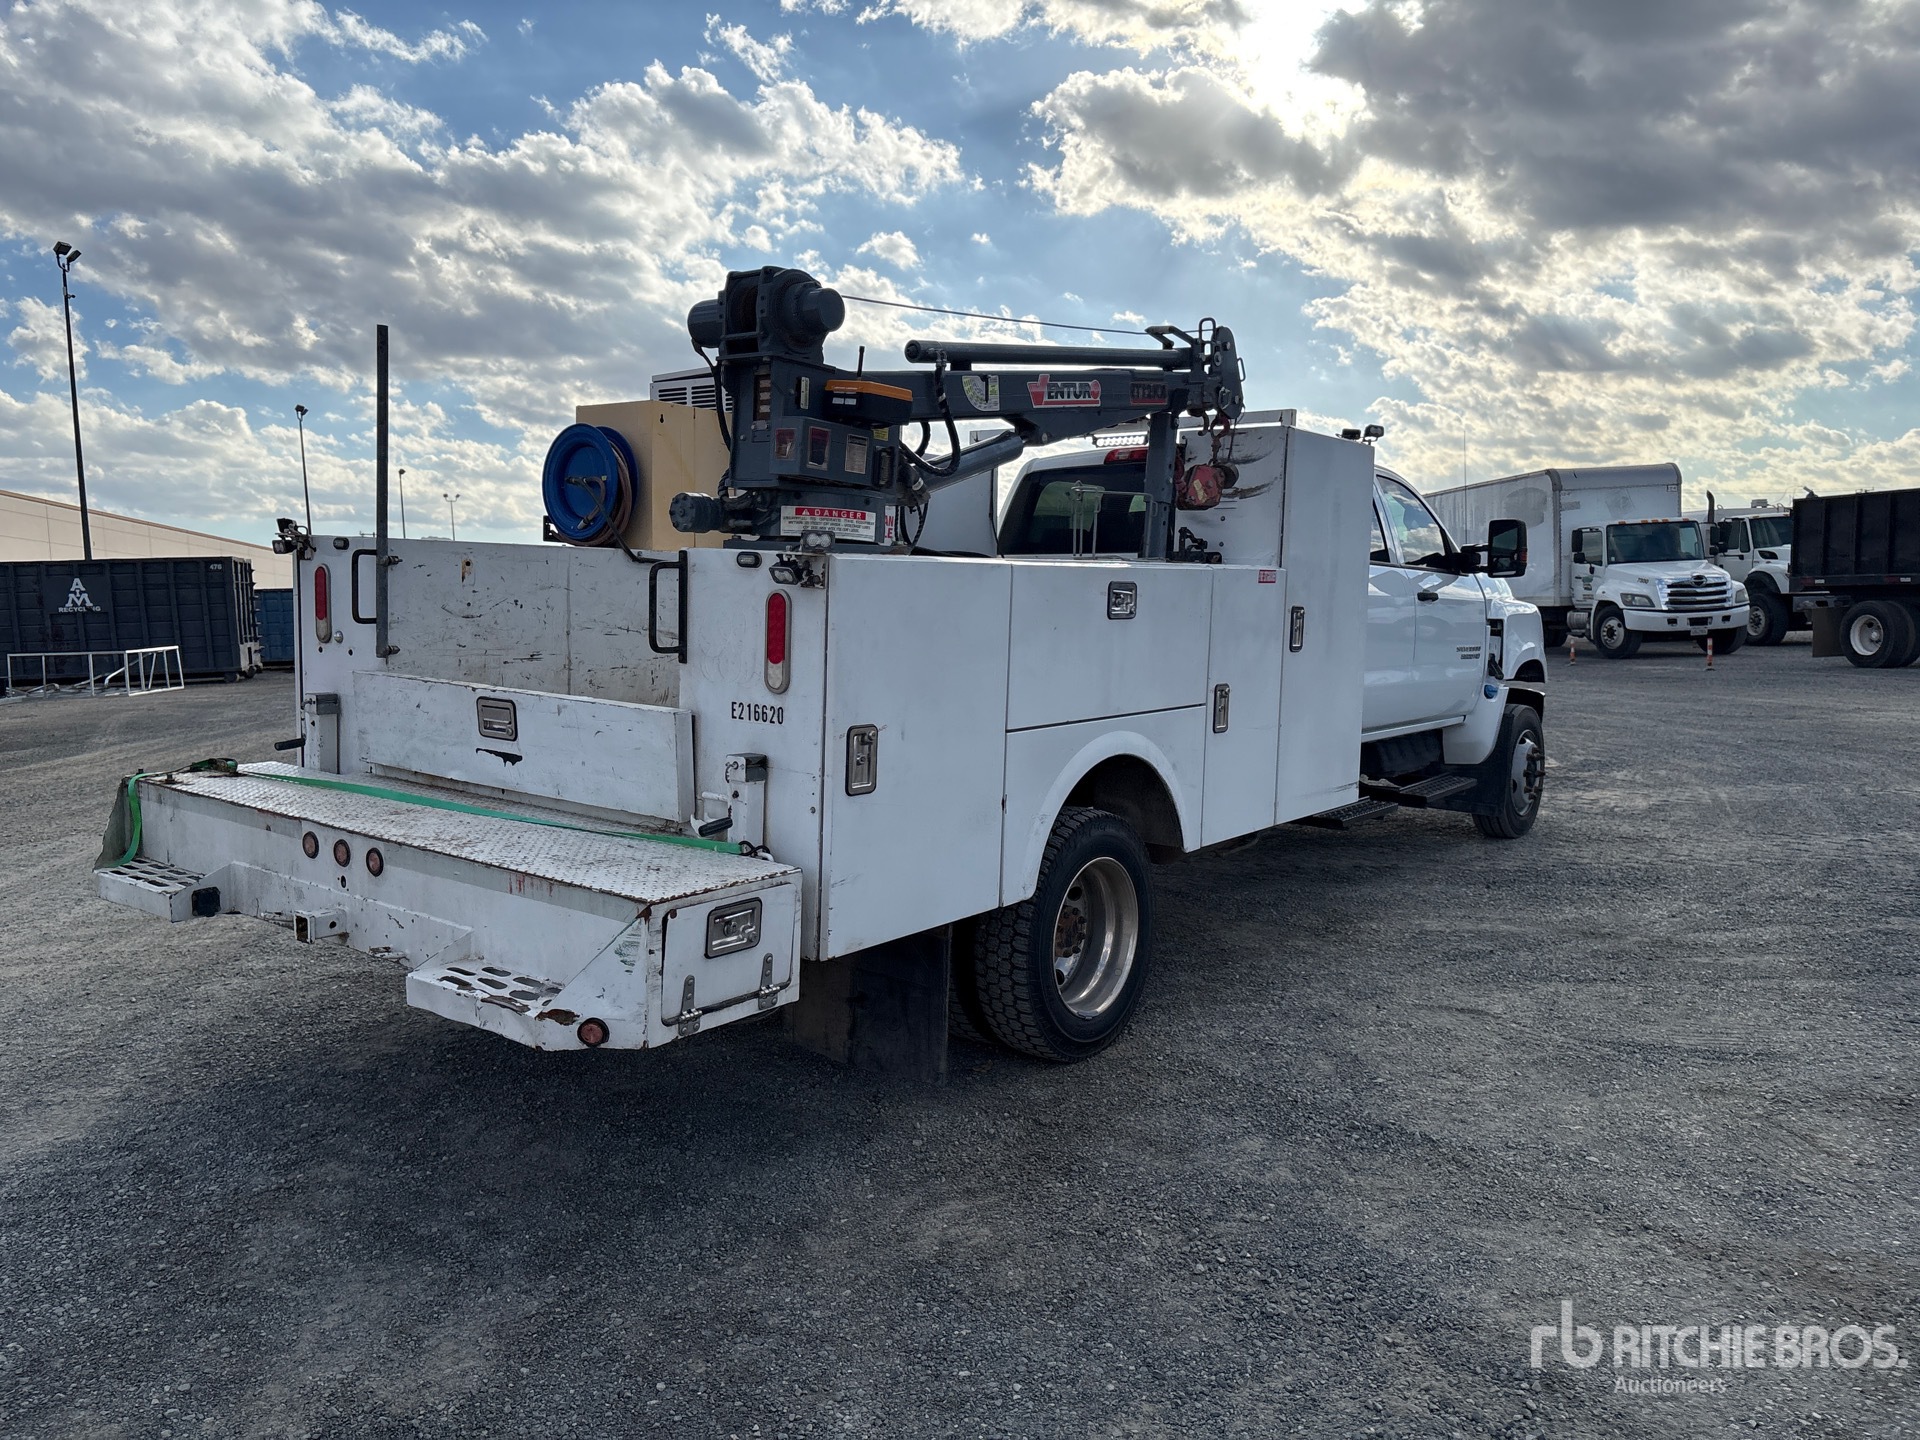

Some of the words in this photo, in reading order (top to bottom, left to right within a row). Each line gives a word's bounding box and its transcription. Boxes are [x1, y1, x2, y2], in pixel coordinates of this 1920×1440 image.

[1027, 374, 1101, 408] VENTURO
[814, 509, 862, 519] DANGER
[731, 701, 784, 725] E216620
